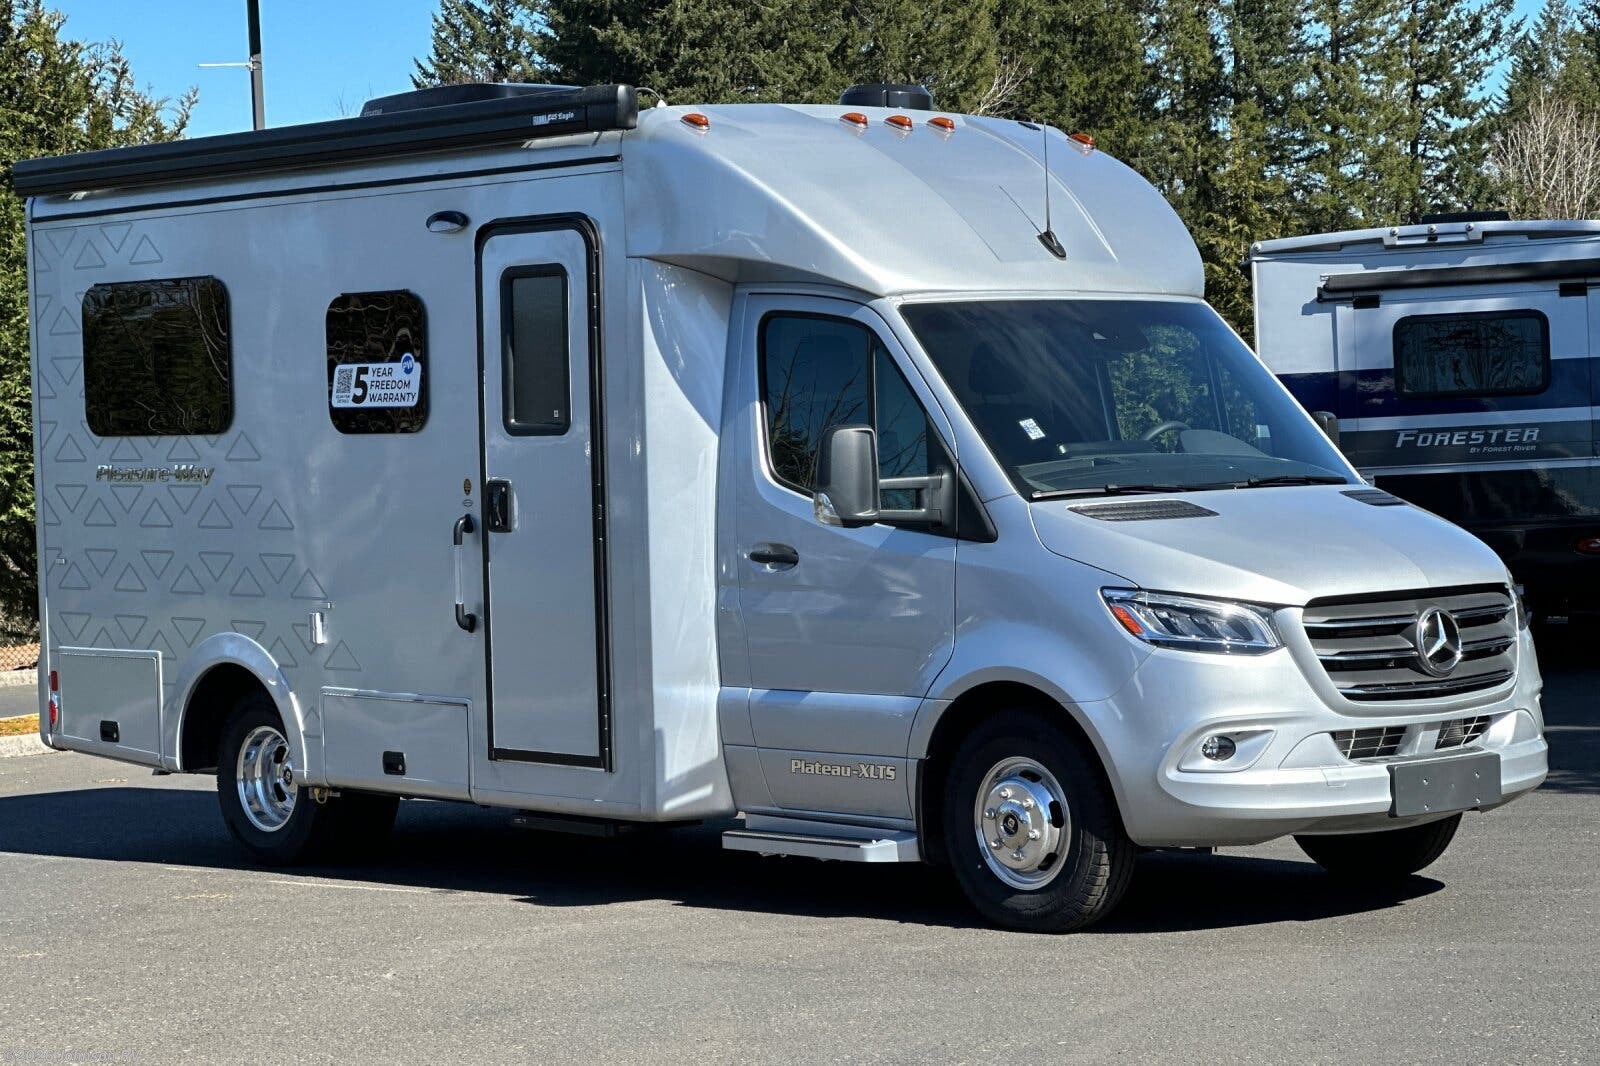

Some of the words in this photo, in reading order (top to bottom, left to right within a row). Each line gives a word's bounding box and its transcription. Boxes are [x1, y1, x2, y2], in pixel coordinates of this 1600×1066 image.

[371, 367, 393, 377] YEAR
[352, 366, 369, 405] 5
[369, 380, 411, 390] FREEDOM
[368, 392, 417, 403] WARRANTY
[1396, 427, 1540, 448] FORESTER
[791, 759, 896, 780] Plateau-XLTS
